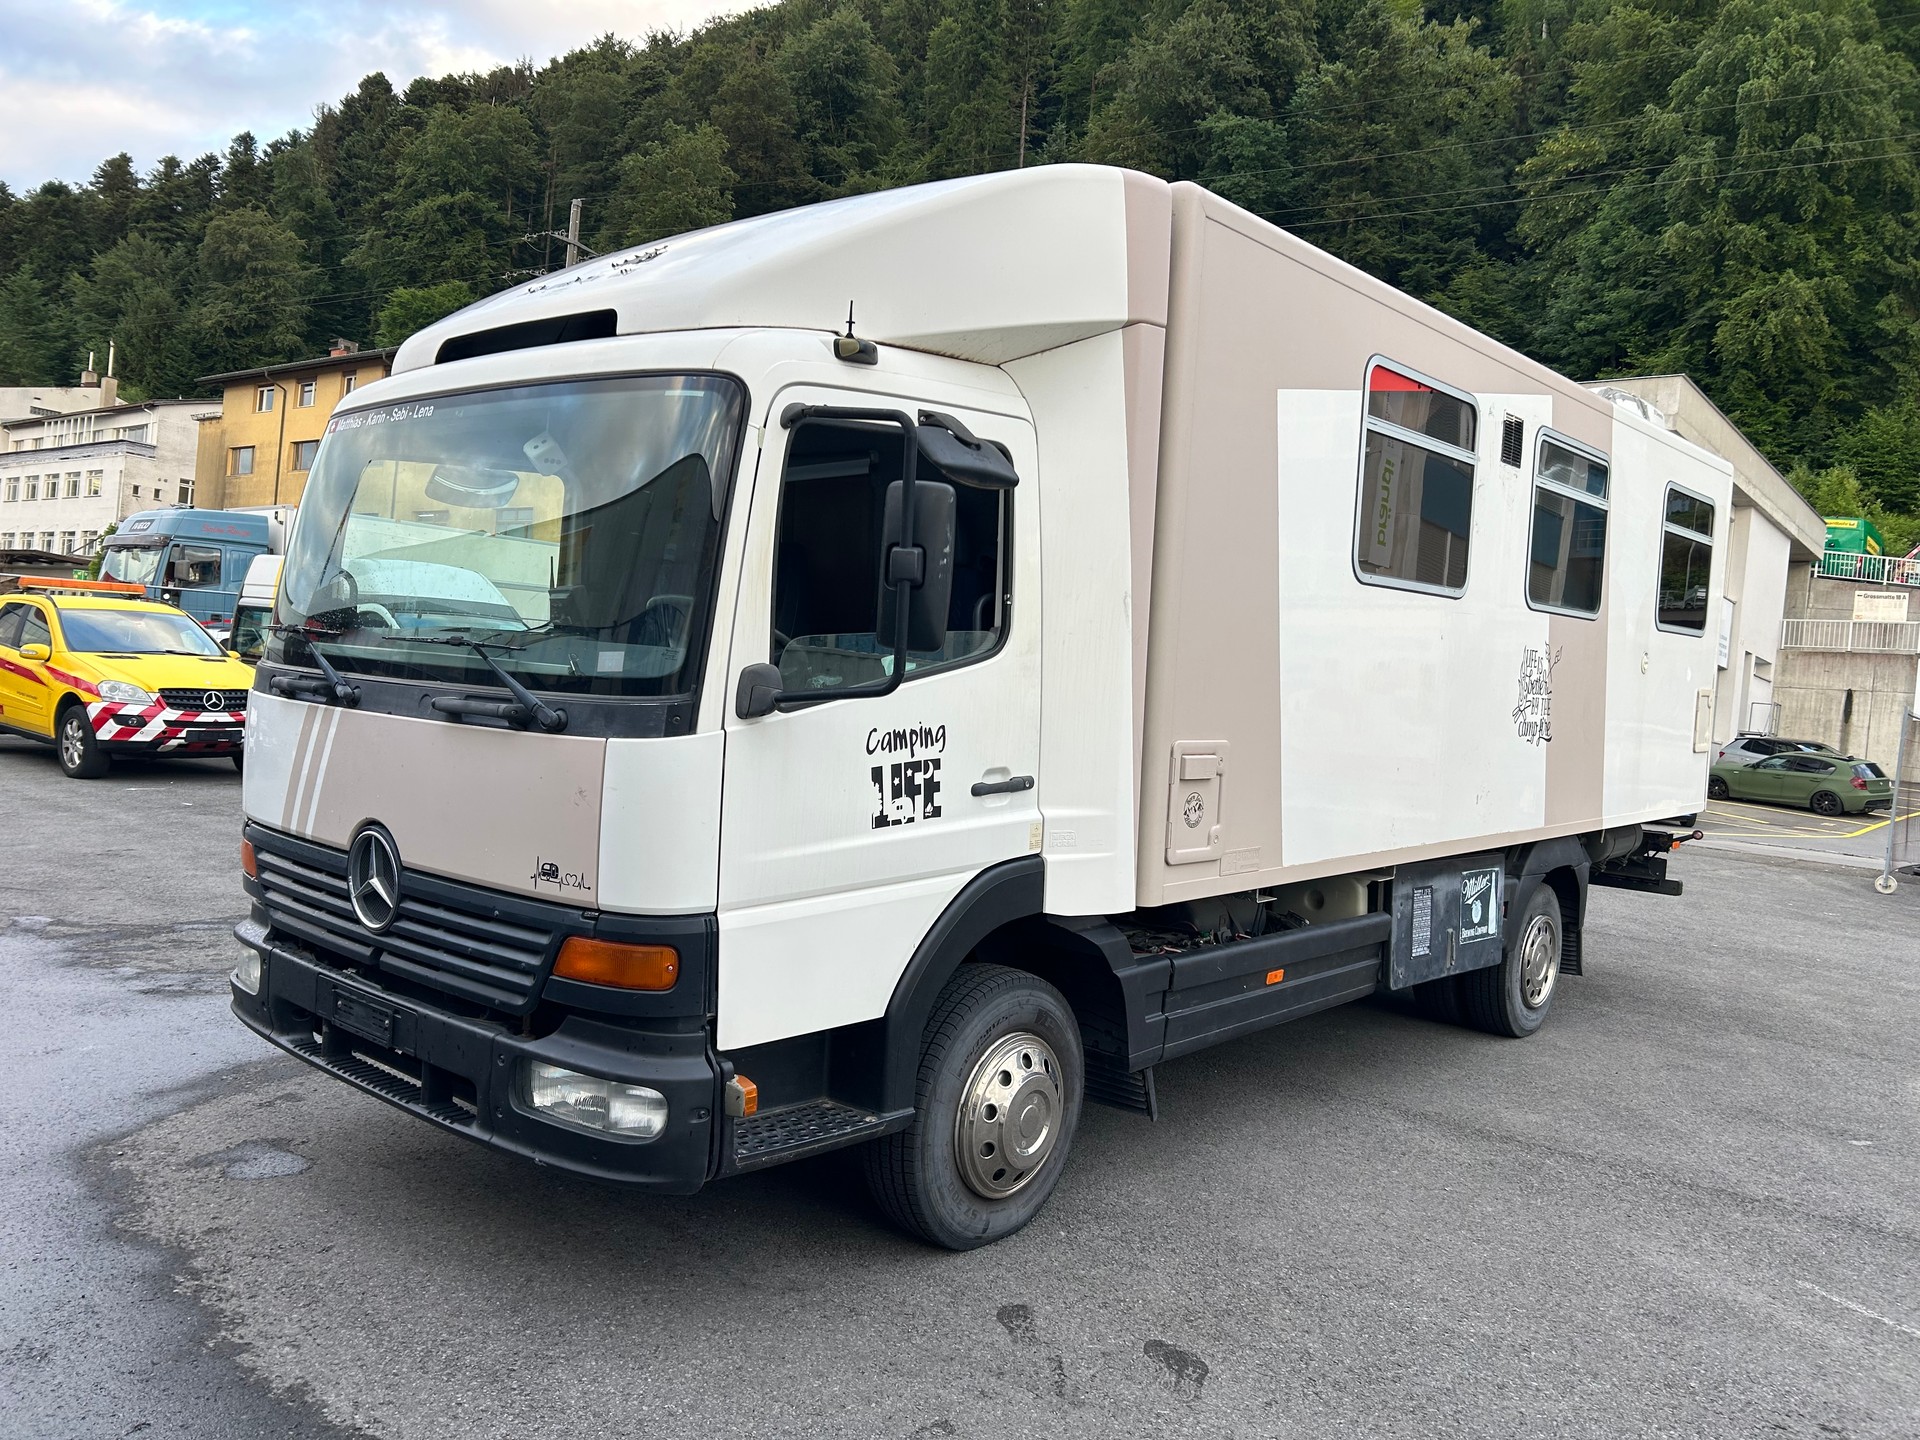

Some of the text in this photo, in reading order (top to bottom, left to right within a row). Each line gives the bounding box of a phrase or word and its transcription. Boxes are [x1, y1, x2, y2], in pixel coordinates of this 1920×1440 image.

[366, 411, 386, 426] Karin
[390, 406, 409, 422] Sebi
[413, 404, 434, 419] Lena
[131, 521, 151, 530] IVECO
[1531, 697, 1552, 716] BY THE
[866, 721, 946, 759] Camping
[871, 757, 942, 830] LIFE
